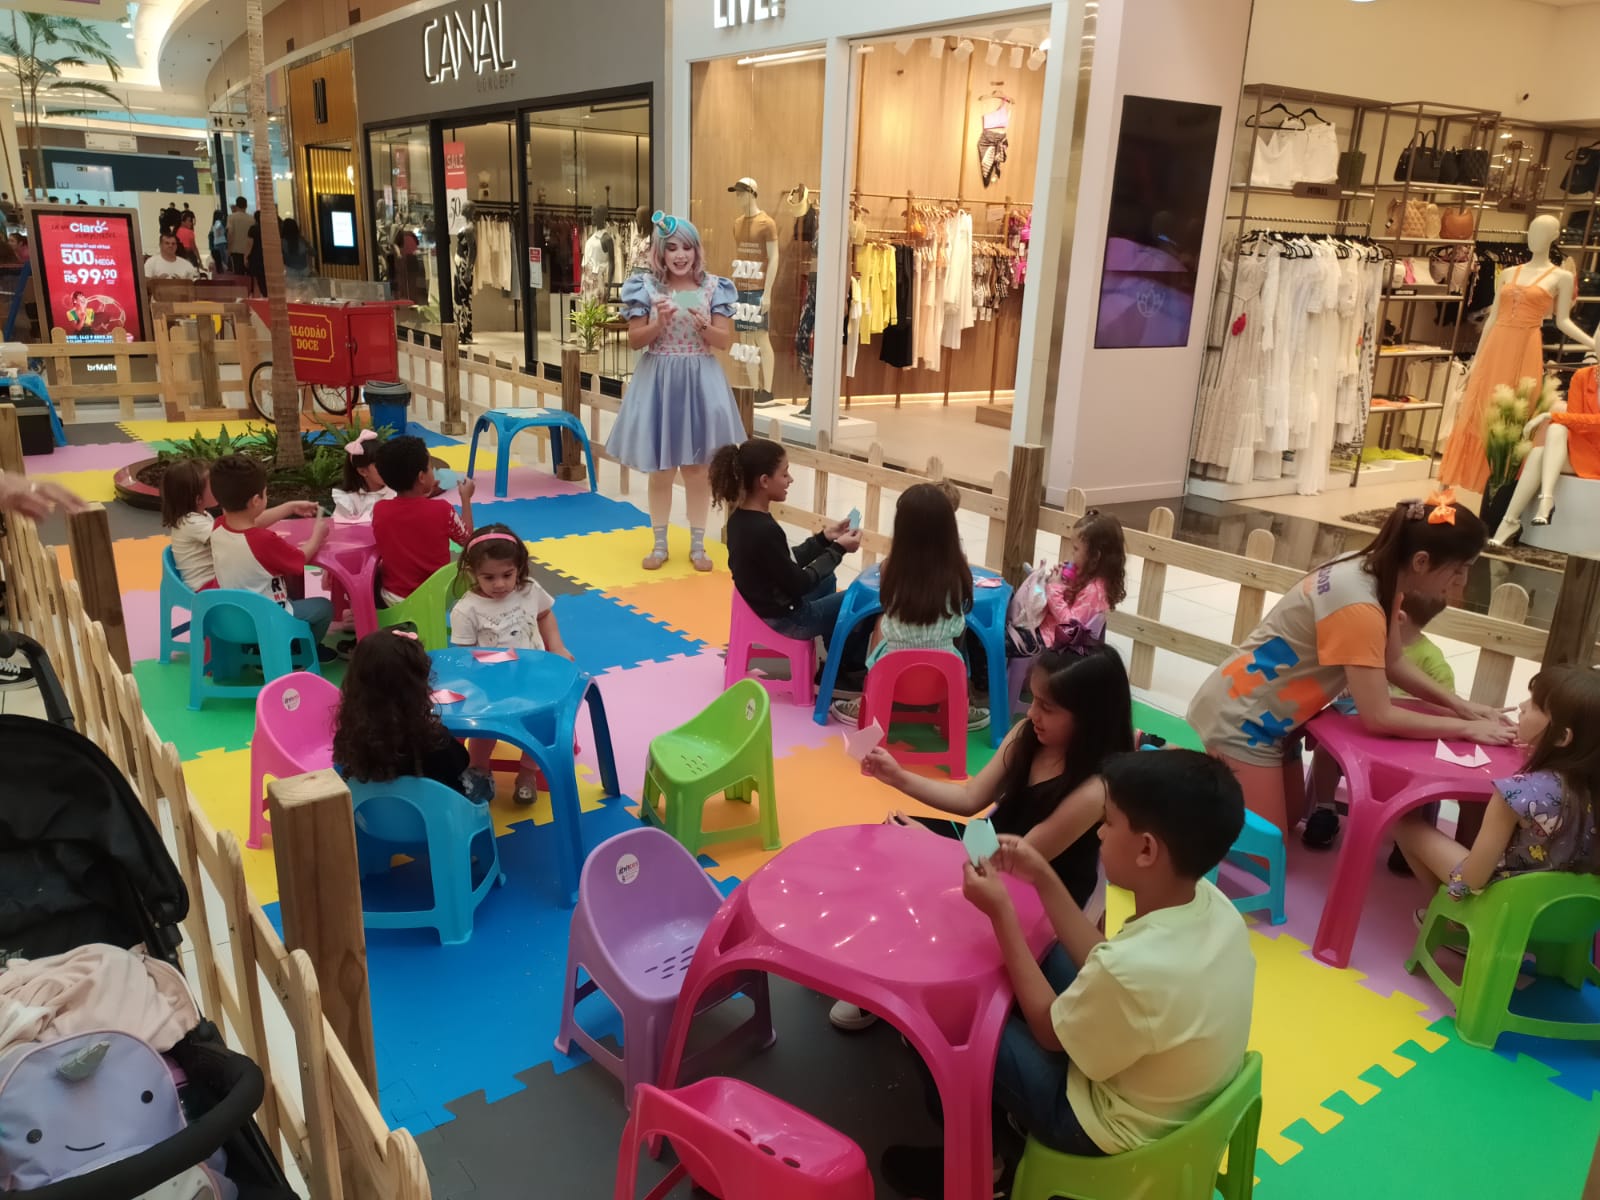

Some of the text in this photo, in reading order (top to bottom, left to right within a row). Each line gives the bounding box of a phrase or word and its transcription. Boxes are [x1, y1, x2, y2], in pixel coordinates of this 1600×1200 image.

[422, 0, 517, 84] CANAL
[478, 73, 516, 92] CONCEPT
[446, 152, 464, 170] SALE
[69, 222, 104, 233] Claro
[61, 248, 116, 266] 500 MEGA
[731, 259, 764, 280] 20%
[296, 339, 319, 351] DOCE
[729, 341, 761, 365] 40%
[87, 363, 117, 372] brMalls
